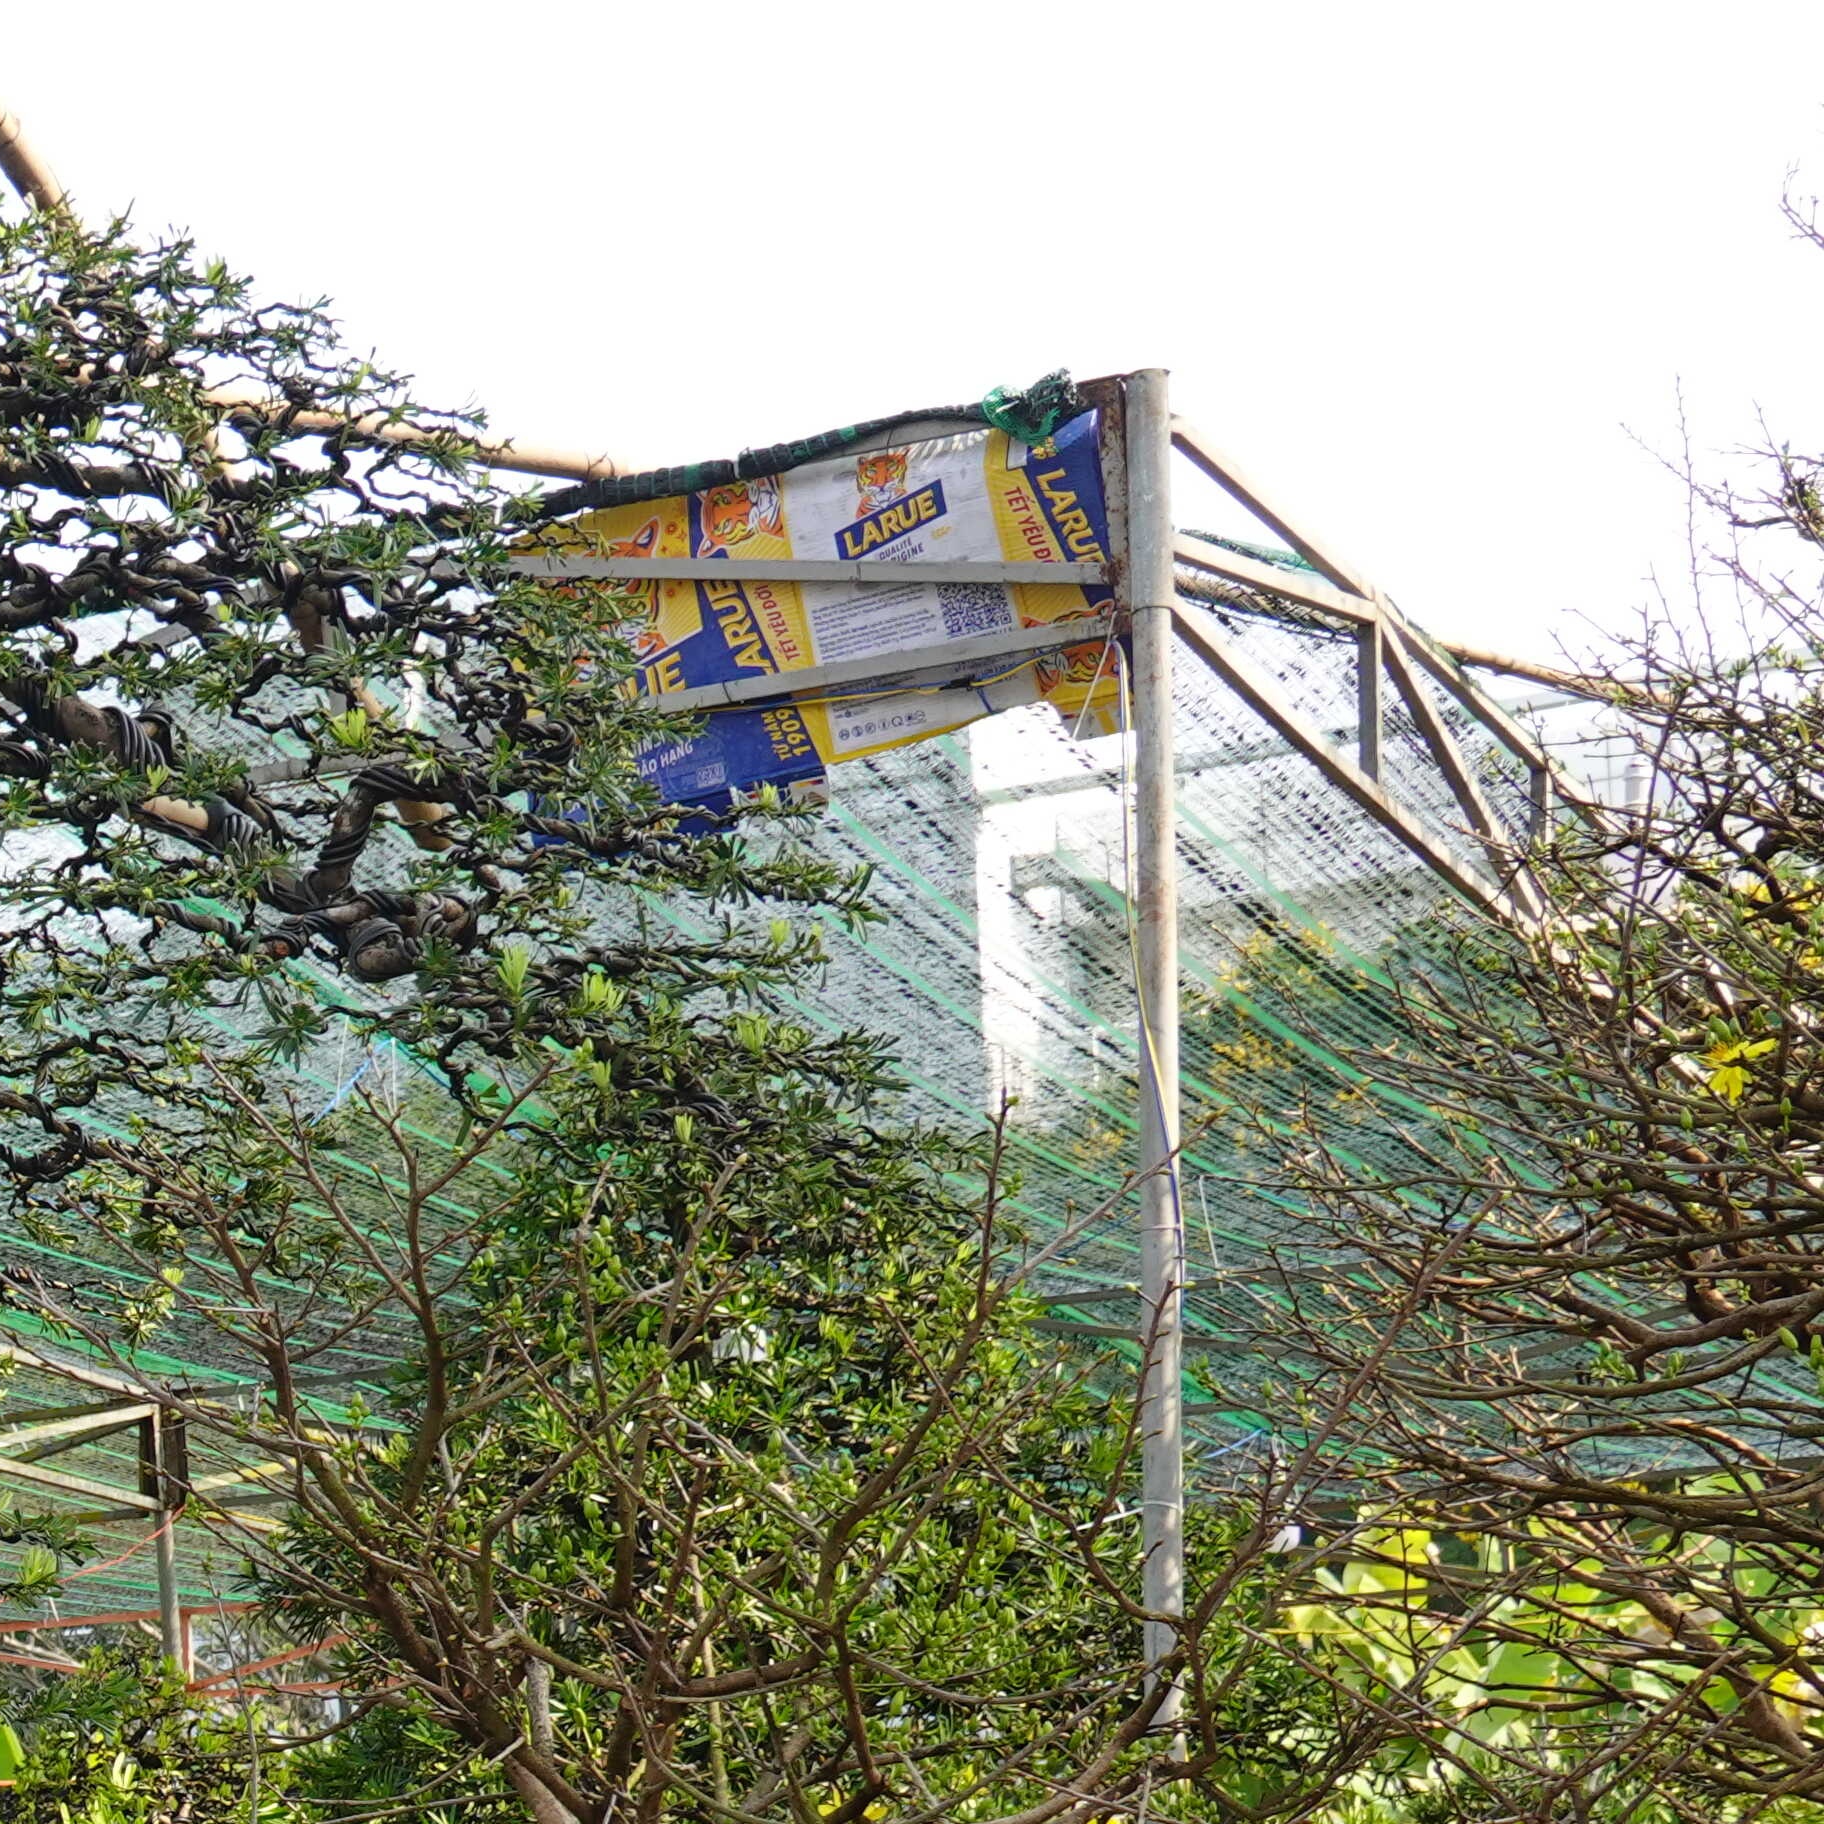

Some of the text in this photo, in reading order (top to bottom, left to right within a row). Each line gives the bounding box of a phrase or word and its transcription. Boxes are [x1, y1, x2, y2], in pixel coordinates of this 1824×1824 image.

[843, 487, 937, 559] LARUE
[1003, 486, 1032, 516] TẾT
[1018, 514, 1045, 548] YÊU
[703, 579, 775, 674] ARUE
[776, 637, 800, 662] TẾT
[660, 740, 694, 770] HẠNG
[776, 708, 811, 758] 1909
